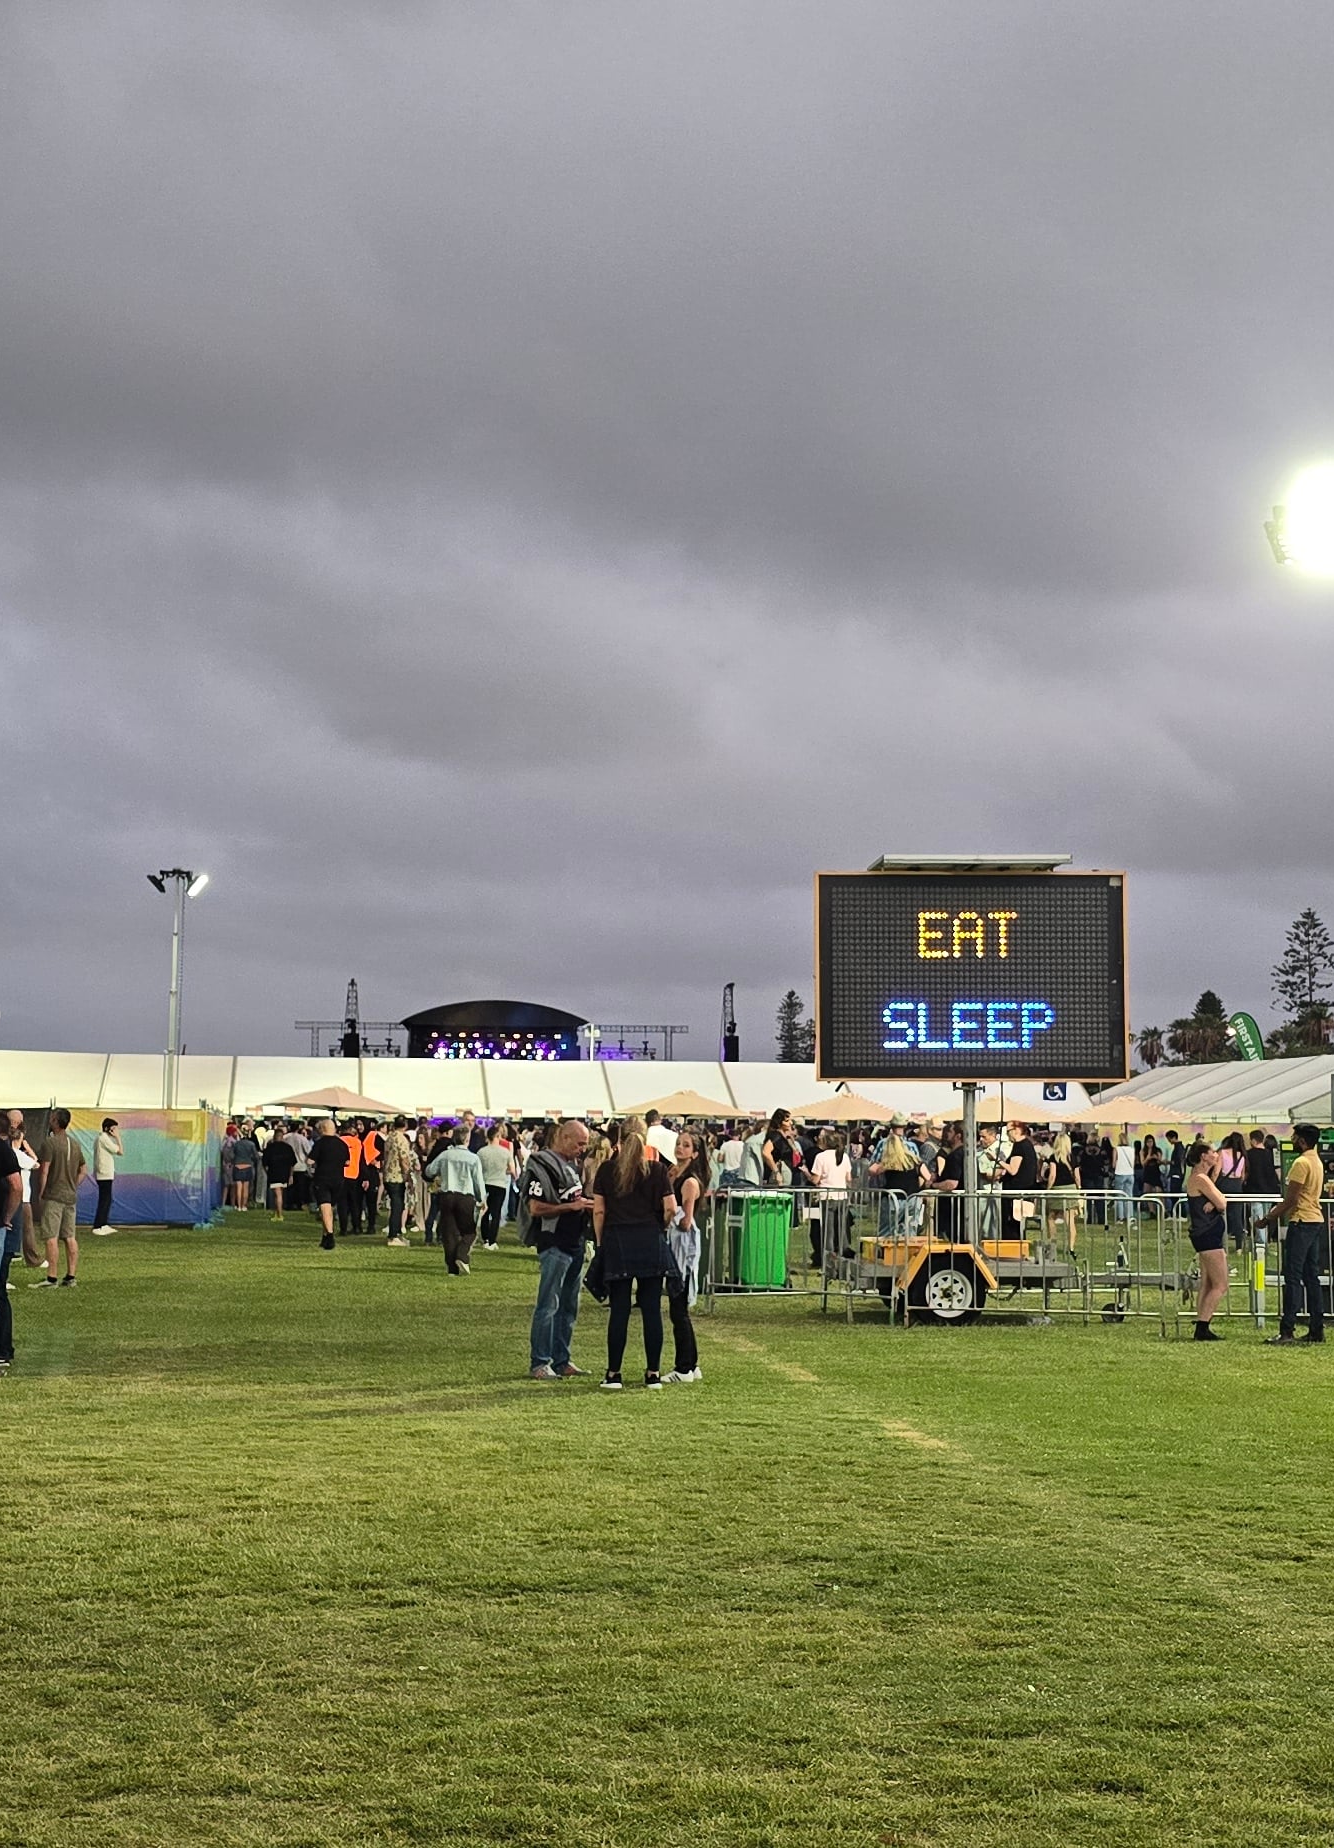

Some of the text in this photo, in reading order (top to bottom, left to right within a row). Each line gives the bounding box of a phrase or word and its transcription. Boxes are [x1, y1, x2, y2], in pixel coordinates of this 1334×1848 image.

[917, 911, 1018, 959] EAT
[881, 1001, 1055, 1050] SLEEP
[1234, 1018, 1253, 1047] FIRST
